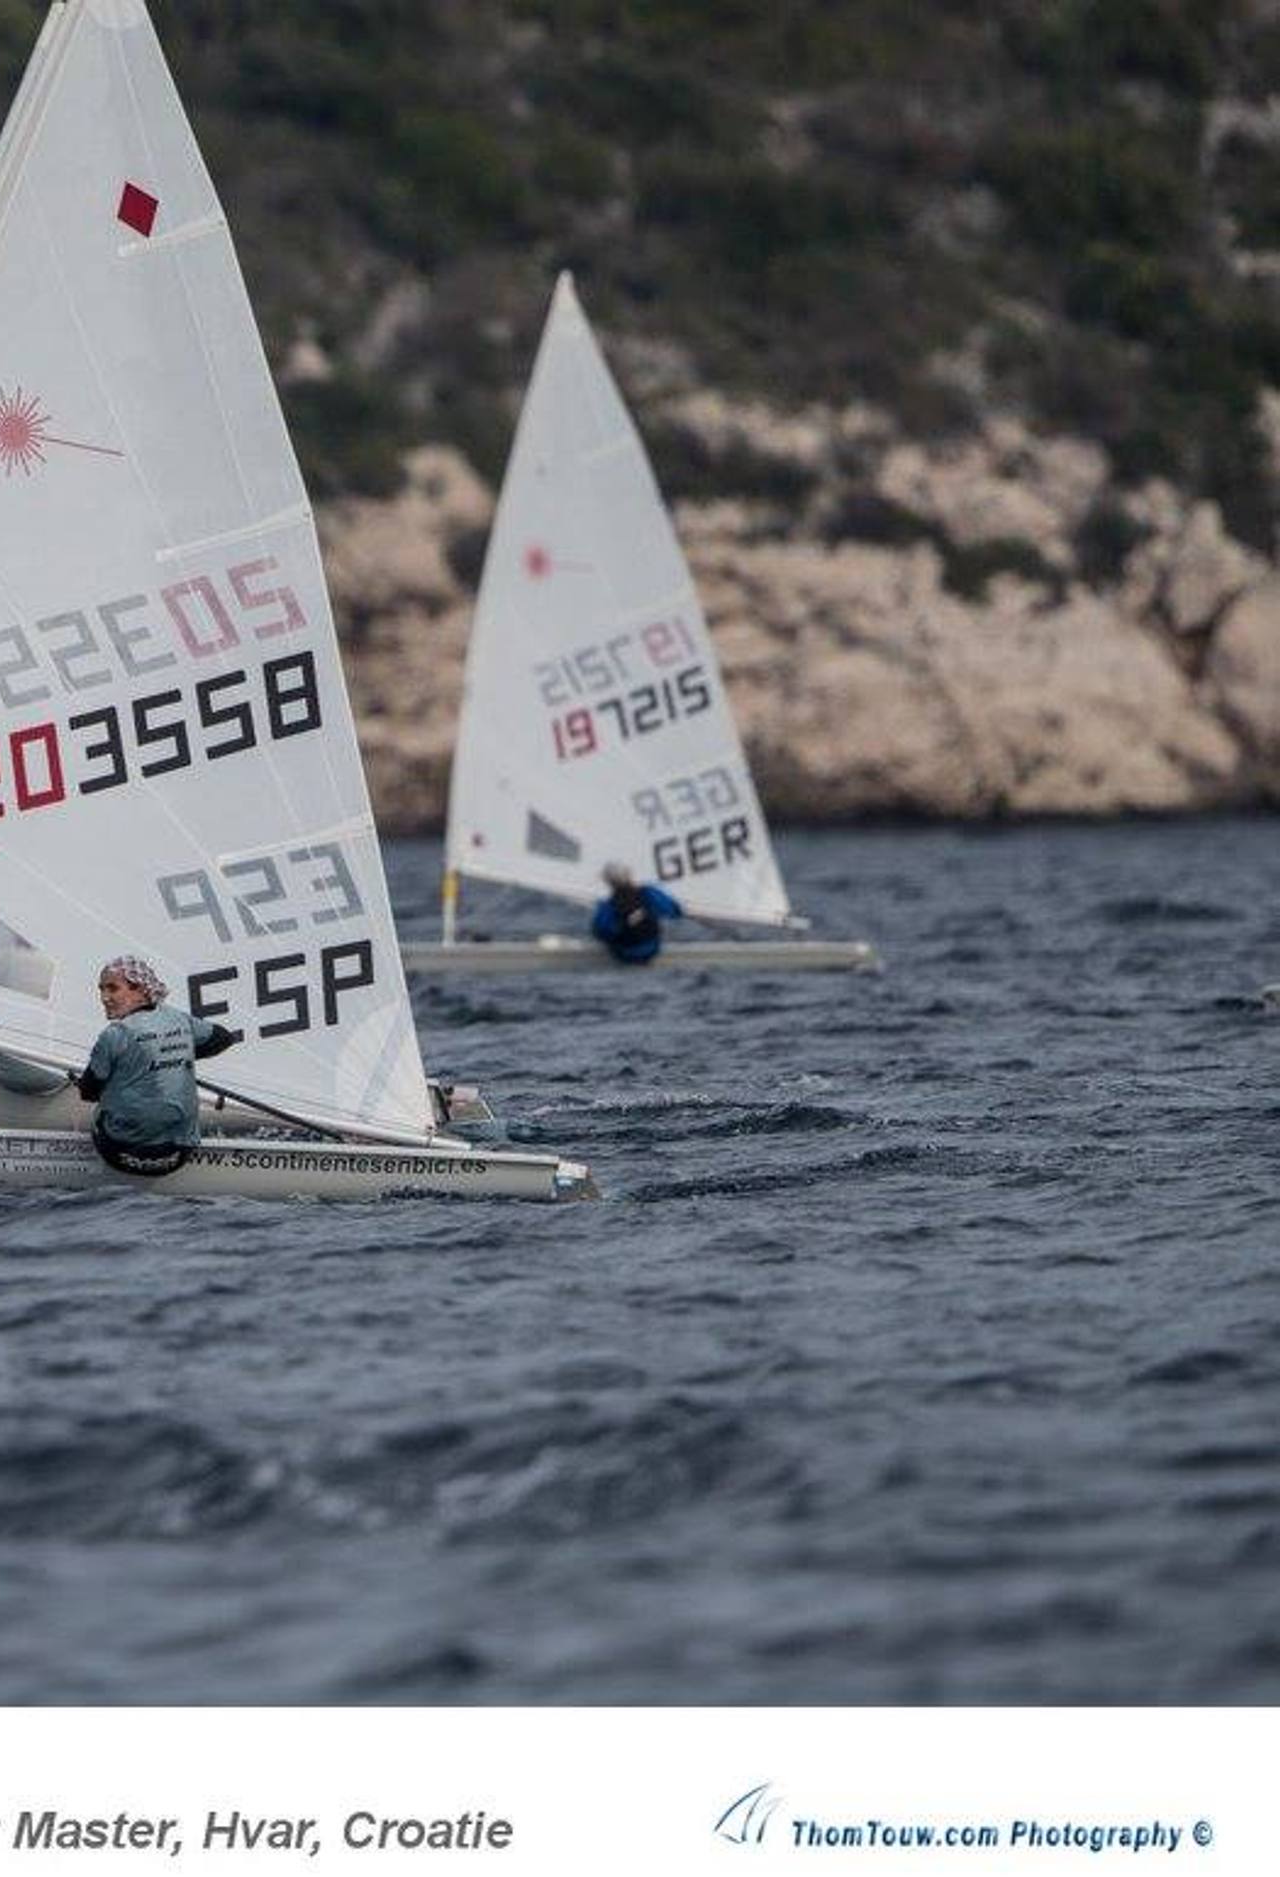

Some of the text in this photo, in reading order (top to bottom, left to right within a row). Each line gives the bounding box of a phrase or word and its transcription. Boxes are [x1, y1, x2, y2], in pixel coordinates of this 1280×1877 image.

[552, 666, 712, 761] 197215
[653, 817, 754, 882] GER
[187, 939, 375, 1046] ESP
[190, 1150, 487, 1175] ww.5continentesenbici.es
